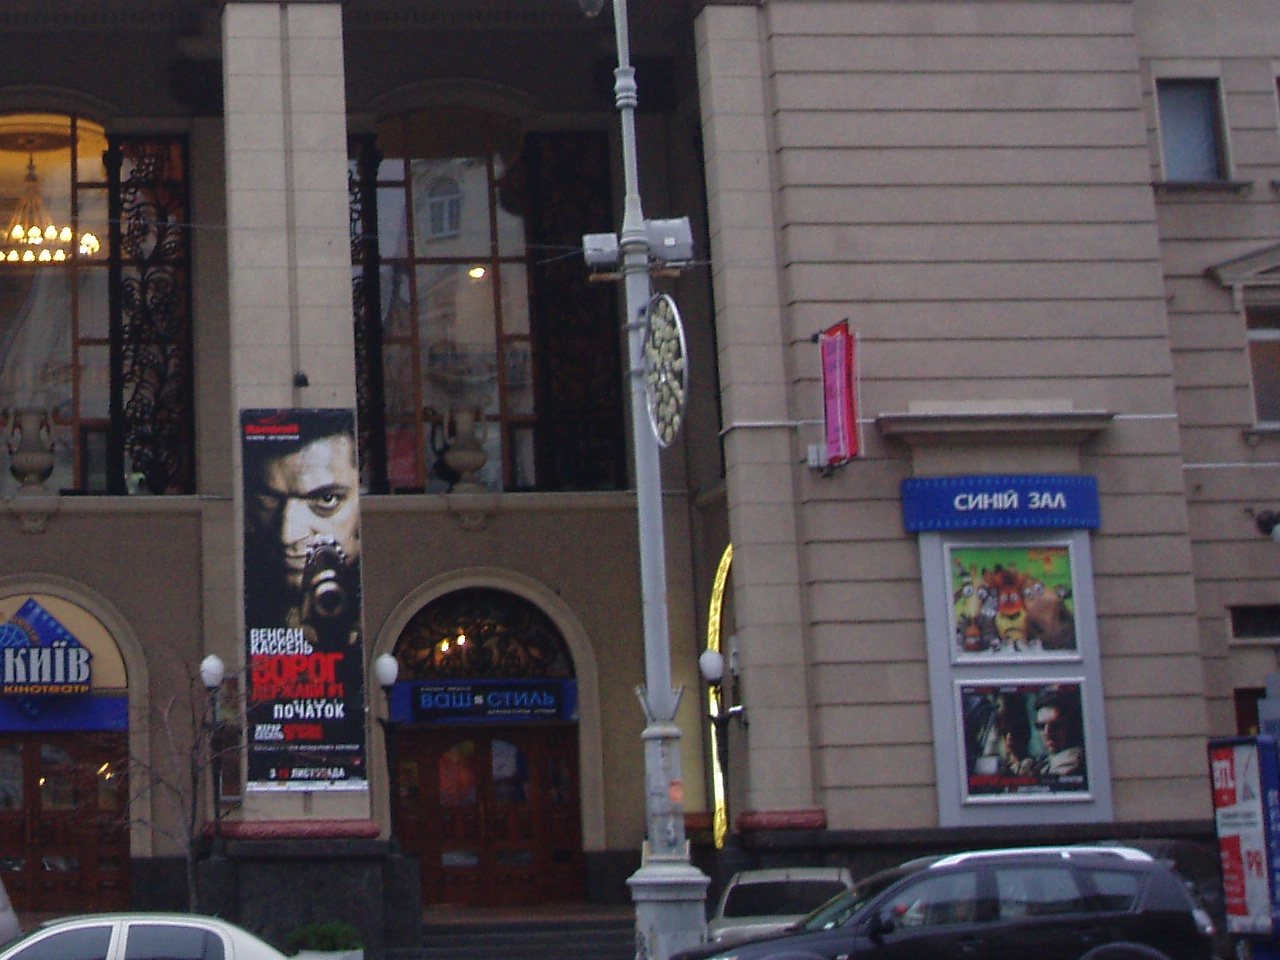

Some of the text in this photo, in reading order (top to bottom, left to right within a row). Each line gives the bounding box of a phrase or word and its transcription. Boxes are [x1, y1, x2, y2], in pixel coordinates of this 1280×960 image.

[953, 489, 1067, 511] СИНІЙ ЗАЛ
[250, 627, 304, 642] ВЕНСАН
[250, 640, 314, 655] КАССЕЛЬ
[4, 640, 91, 683] КИЇВ
[251, 652, 346, 685] ВОРОГ
[488, 692, 555, 707] СТИЛЬ
